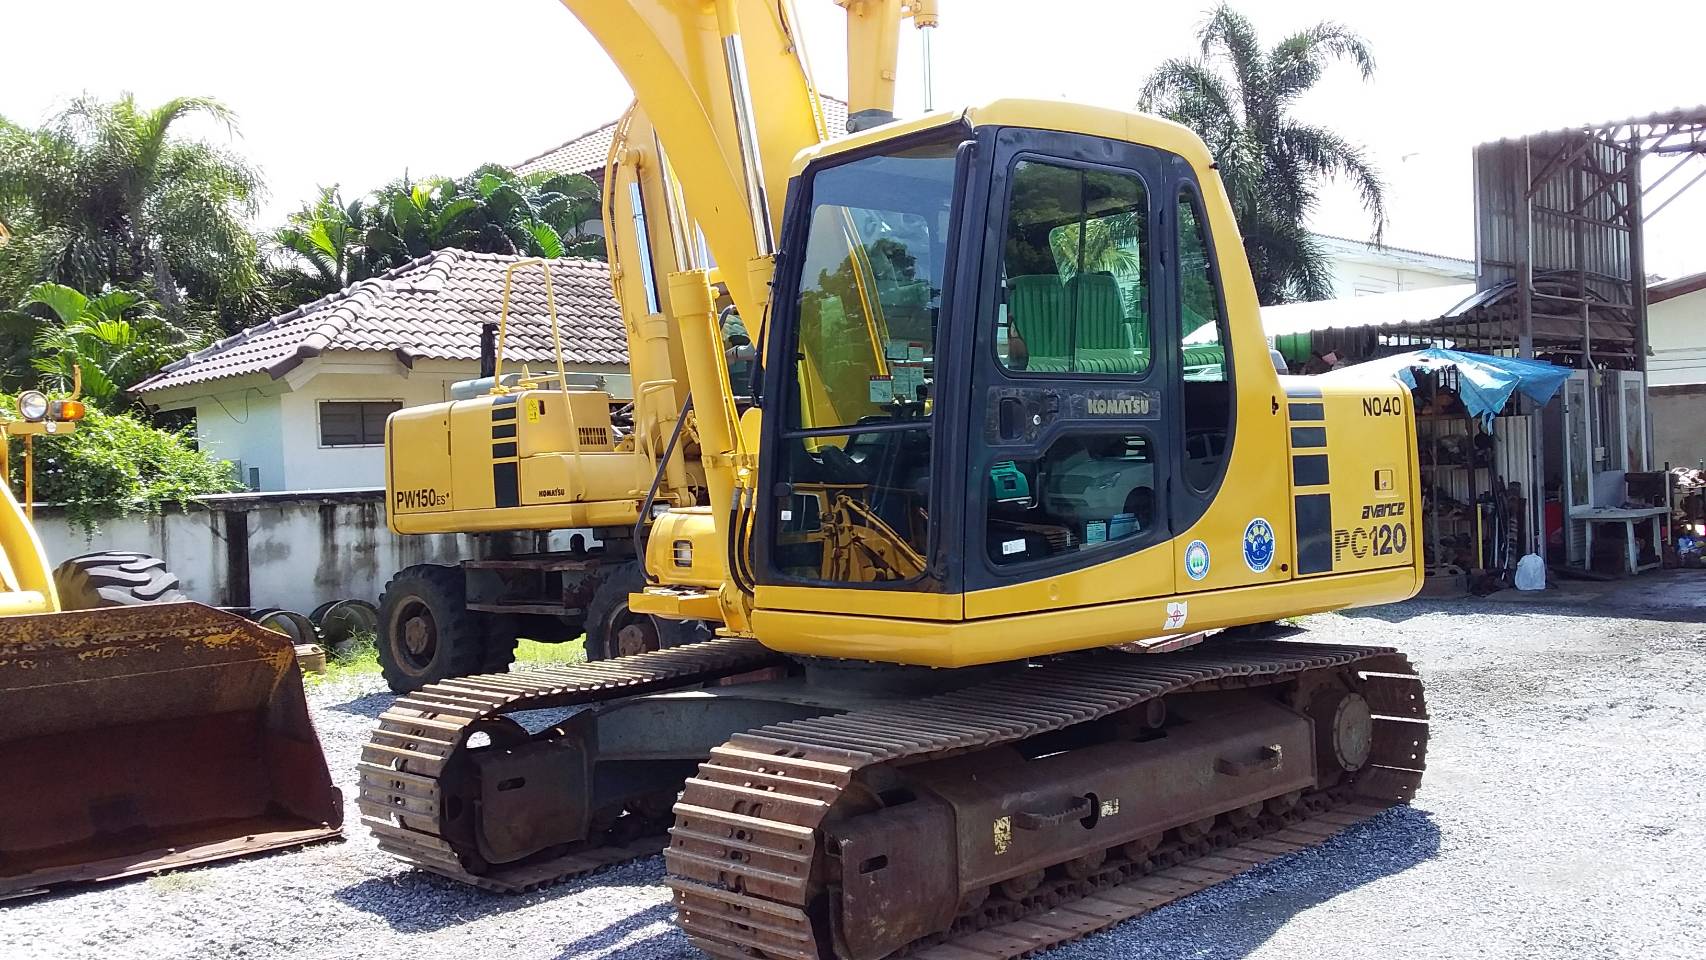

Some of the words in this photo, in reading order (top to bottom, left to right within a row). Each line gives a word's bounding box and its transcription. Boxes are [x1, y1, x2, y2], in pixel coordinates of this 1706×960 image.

[1088, 396, 1149, 414] KOMATSU
[538, 487, 565, 497] KOMATSU
[1361, 502, 1406, 519] avance
[1334, 522, 1407, 562] PC120
